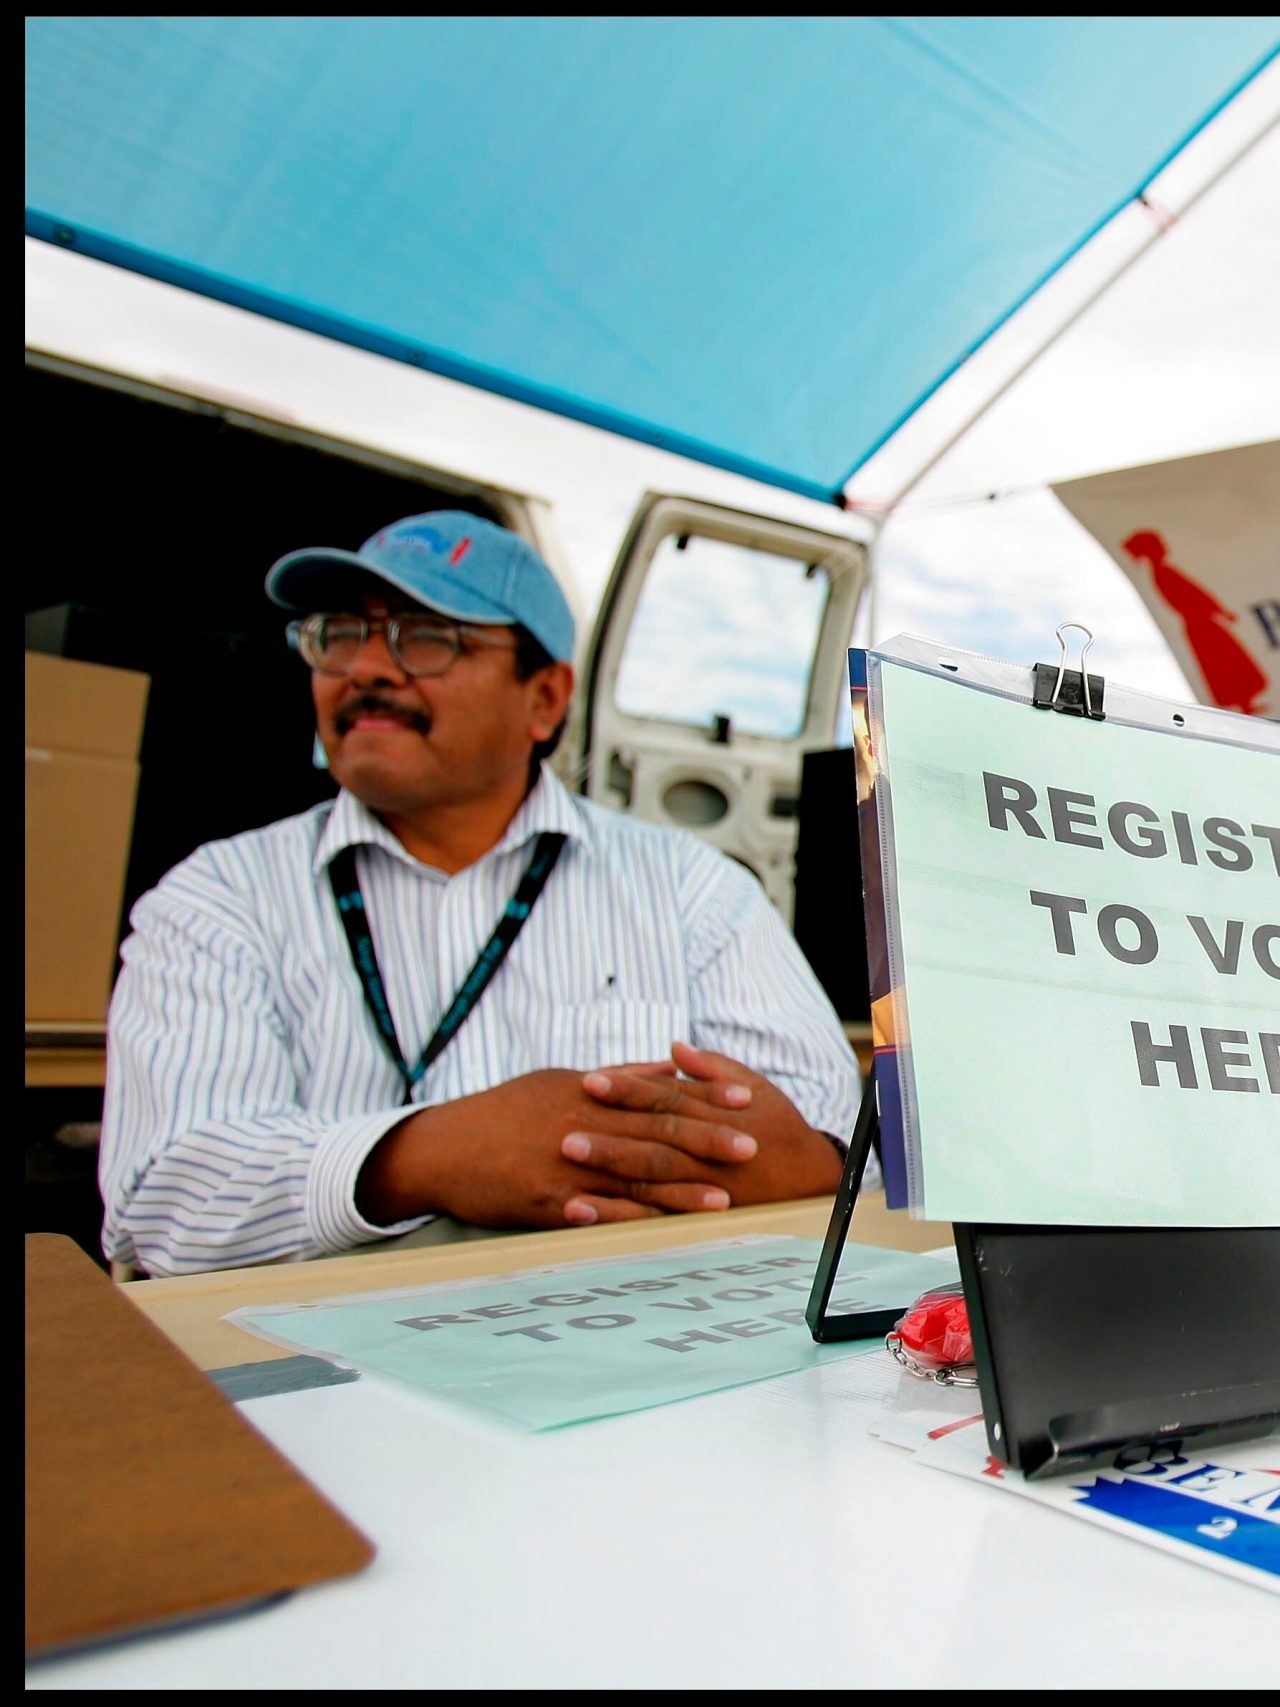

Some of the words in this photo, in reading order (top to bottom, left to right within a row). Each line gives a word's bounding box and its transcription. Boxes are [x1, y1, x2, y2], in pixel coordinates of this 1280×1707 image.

[1029, 889, 1160, 966] TO
[394, 1256, 818, 1332] REGISTER
[493, 1312, 638, 1343] TO
[1112, 1440, 1246, 1493] BE
